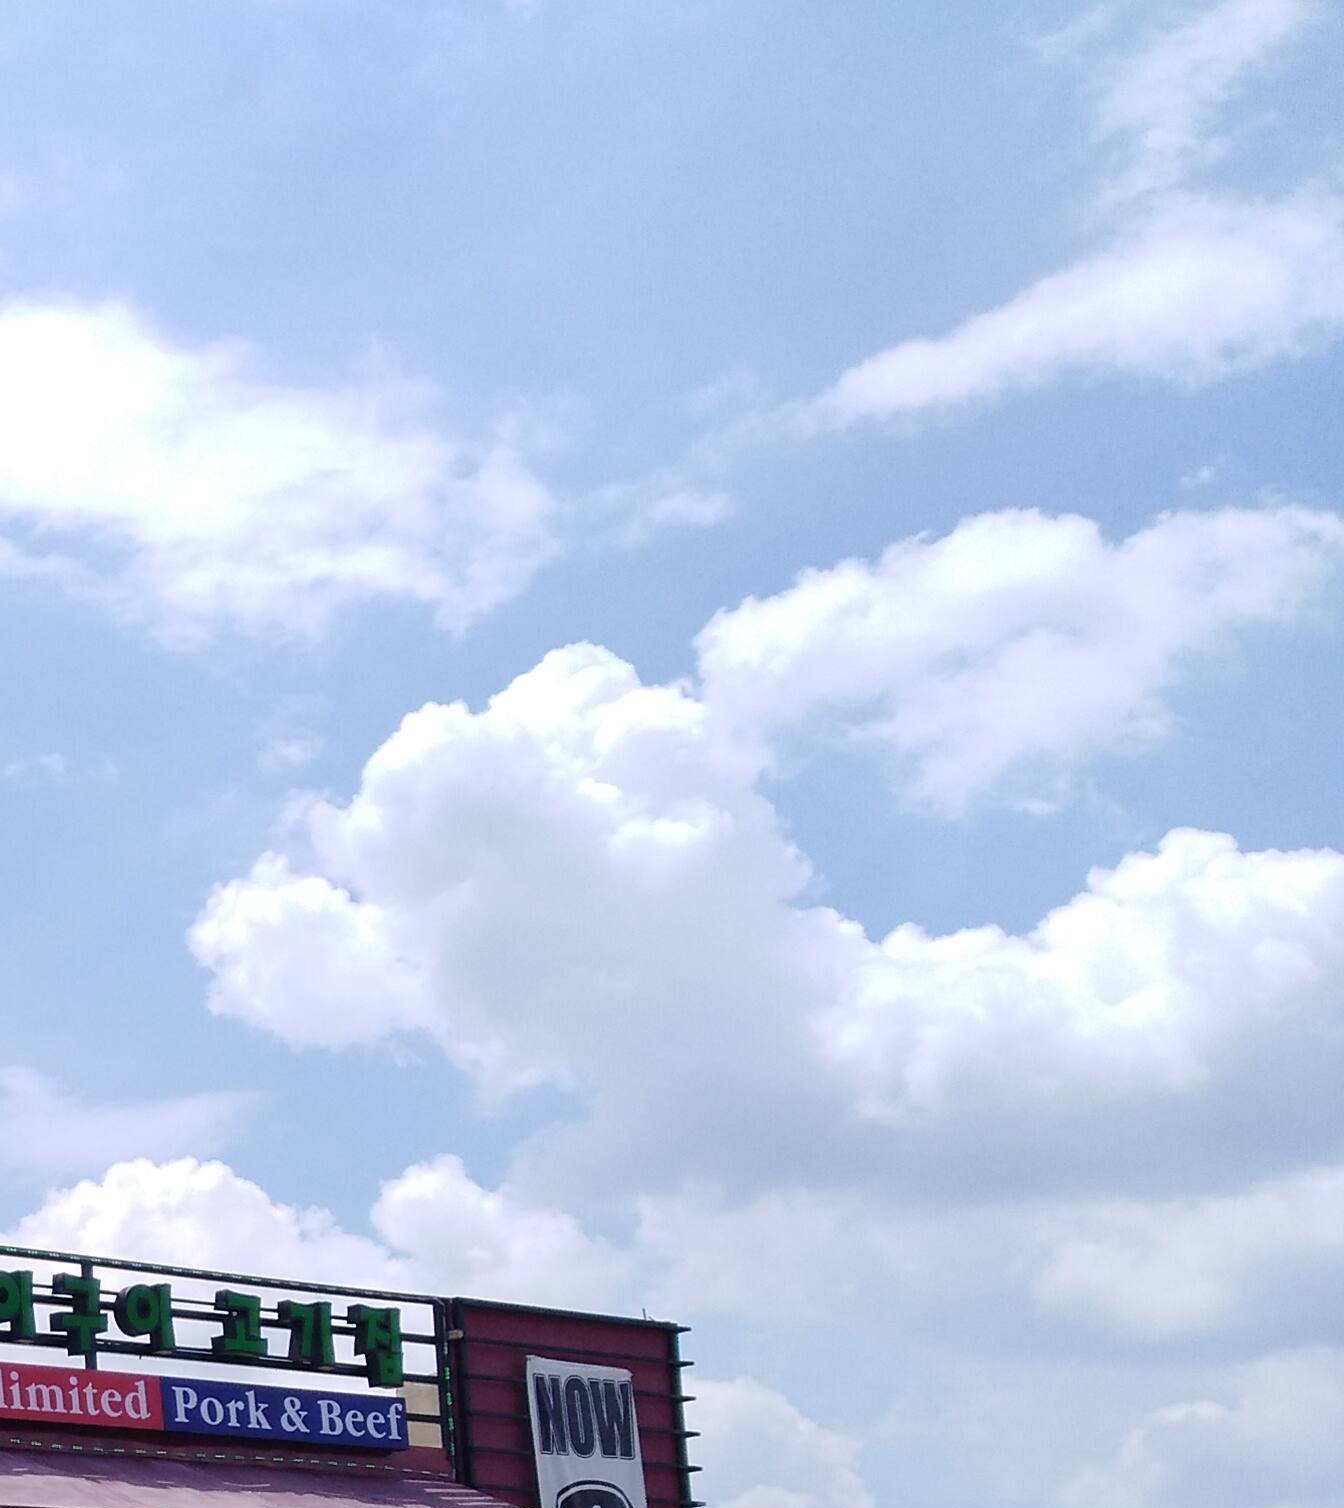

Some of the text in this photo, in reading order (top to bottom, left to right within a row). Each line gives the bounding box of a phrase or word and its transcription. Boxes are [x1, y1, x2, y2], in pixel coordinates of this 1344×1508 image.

[171, 1385, 272, 1431] Pork
[279, 1396, 311, 1434] &
[317, 1398, 404, 1442] Beef
[533, 1373, 636, 1461] NOW
